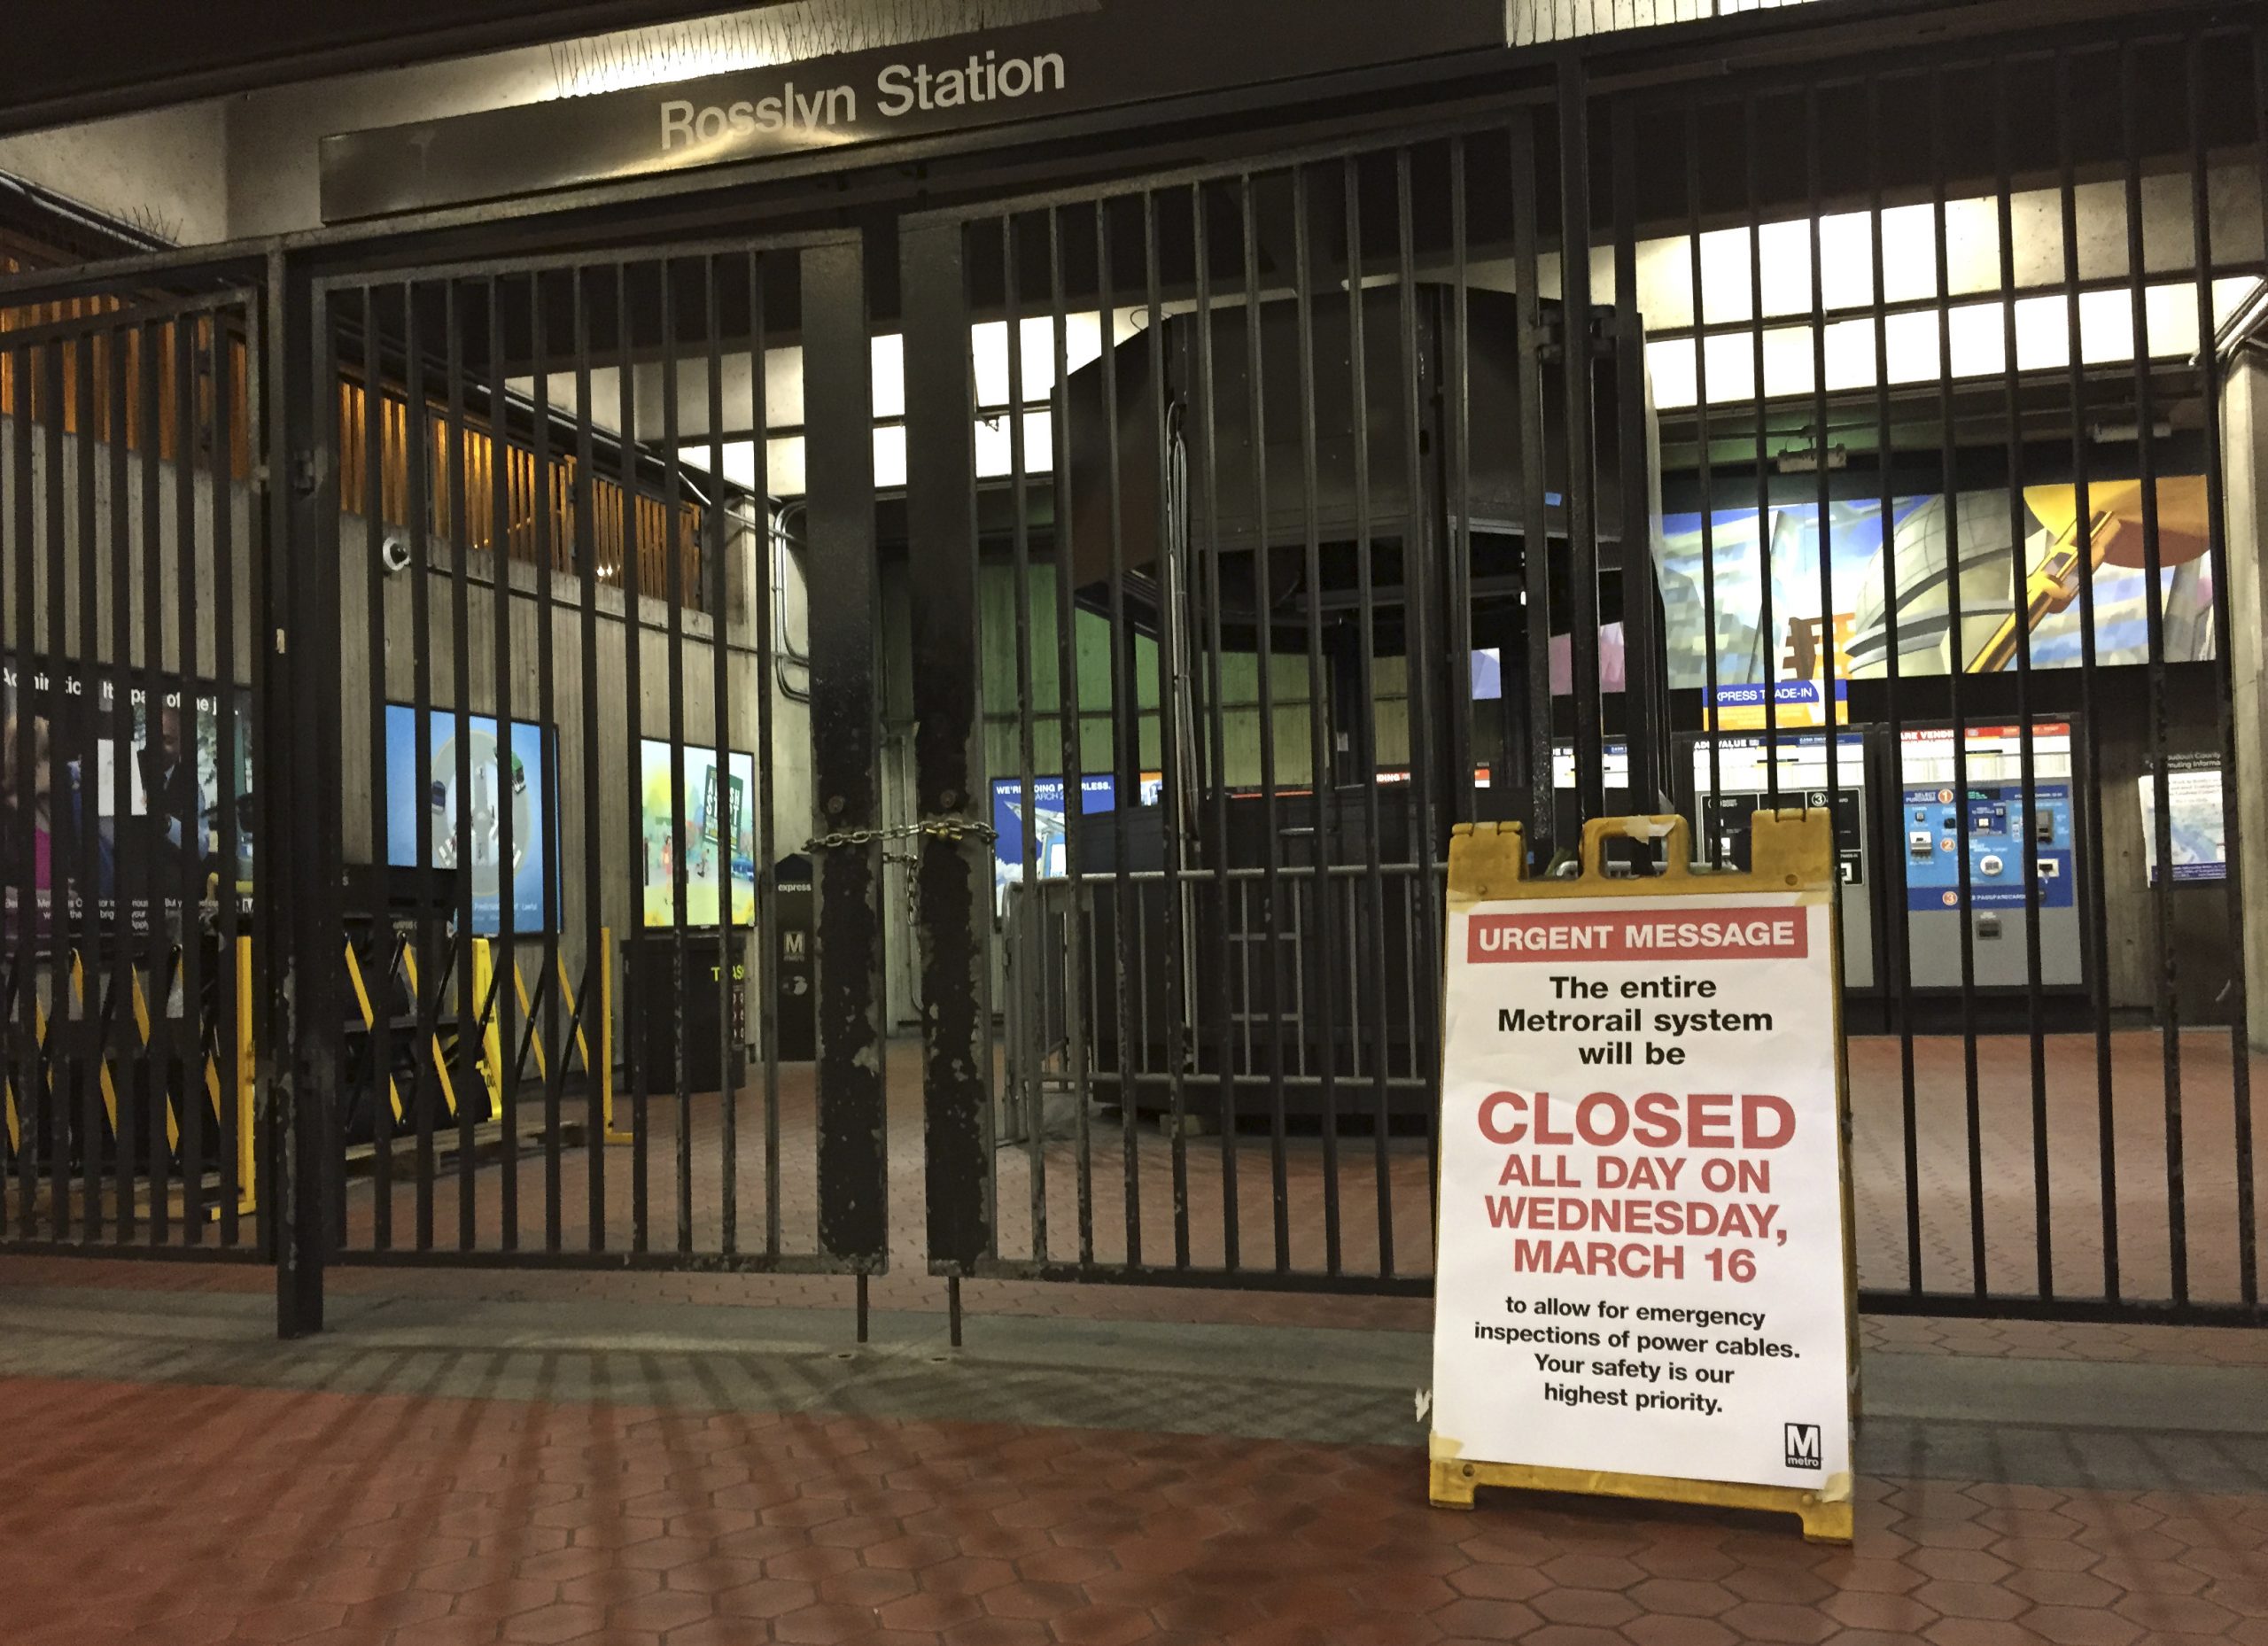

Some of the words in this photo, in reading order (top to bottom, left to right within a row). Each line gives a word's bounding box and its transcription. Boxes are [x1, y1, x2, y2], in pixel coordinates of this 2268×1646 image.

[660, 82, 856, 151] Rosslyn
[877, 50, 1065, 117] Station
[1717, 690, 1758, 702] XPRESS
[1759, 687, 1813, 701] TADE-IN
[1694, 740, 1710, 749] AD
[996, 785, 1021, 795] WE'R
[1034, 783, 1055, 793] OING
[1058, 781, 1112, 792] PRLESS.
[1035, 793, 1059, 802] ARCH
[785, 933, 803, 953] M
[1479, 926, 1613, 951] URGENT
[1626, 920, 1795, 948] MESSAGE
[1550, 976, 1609, 998] The
[1620, 975, 1717, 998] entire
[1498, 1009, 1642, 1032] Metrorail
[1654, 1011, 1773, 1037] system
[1579, 1042, 1632, 1065] will
[1646, 1042, 1686, 1065] be
[1478, 1091, 1796, 1149] CLOSED
[1498, 1153, 1581, 1188] ALL
[1596, 1155, 1687, 1191] DAY
[1701, 1158, 1770, 1193] ON
[1485, 1195, 1787, 1246] WEDNESDAY,
[1514, 1238, 1684, 1279] MARCH
[1705, 1248, 1756, 1283] 16
[1506, 1297, 1527, 1314] to
[1534, 1299, 1590, 1317] allow
[1597, 1301, 1629, 1319] for
[1636, 1305, 1766, 1331] emergency
[1474, 1323, 1600, 1346] inspections
[1608, 1329, 1630, 1347] of
[1637, 1333, 1708, 1352] power
[1715, 1338, 1800, 1358] cables.
[1534, 1355, 1585, 1374] Your
[1591, 1359, 1660, 1382] safety
[1669, 1362, 1688, 1380] is
[1695, 1365, 1735, 1384] our
[1544, 1383, 1627, 1407] highest
[1635, 1390, 1722, 1415] priority.
[1787, 1425, 1819, 1457] M
[1788, 1457, 1819, 1467] metro
